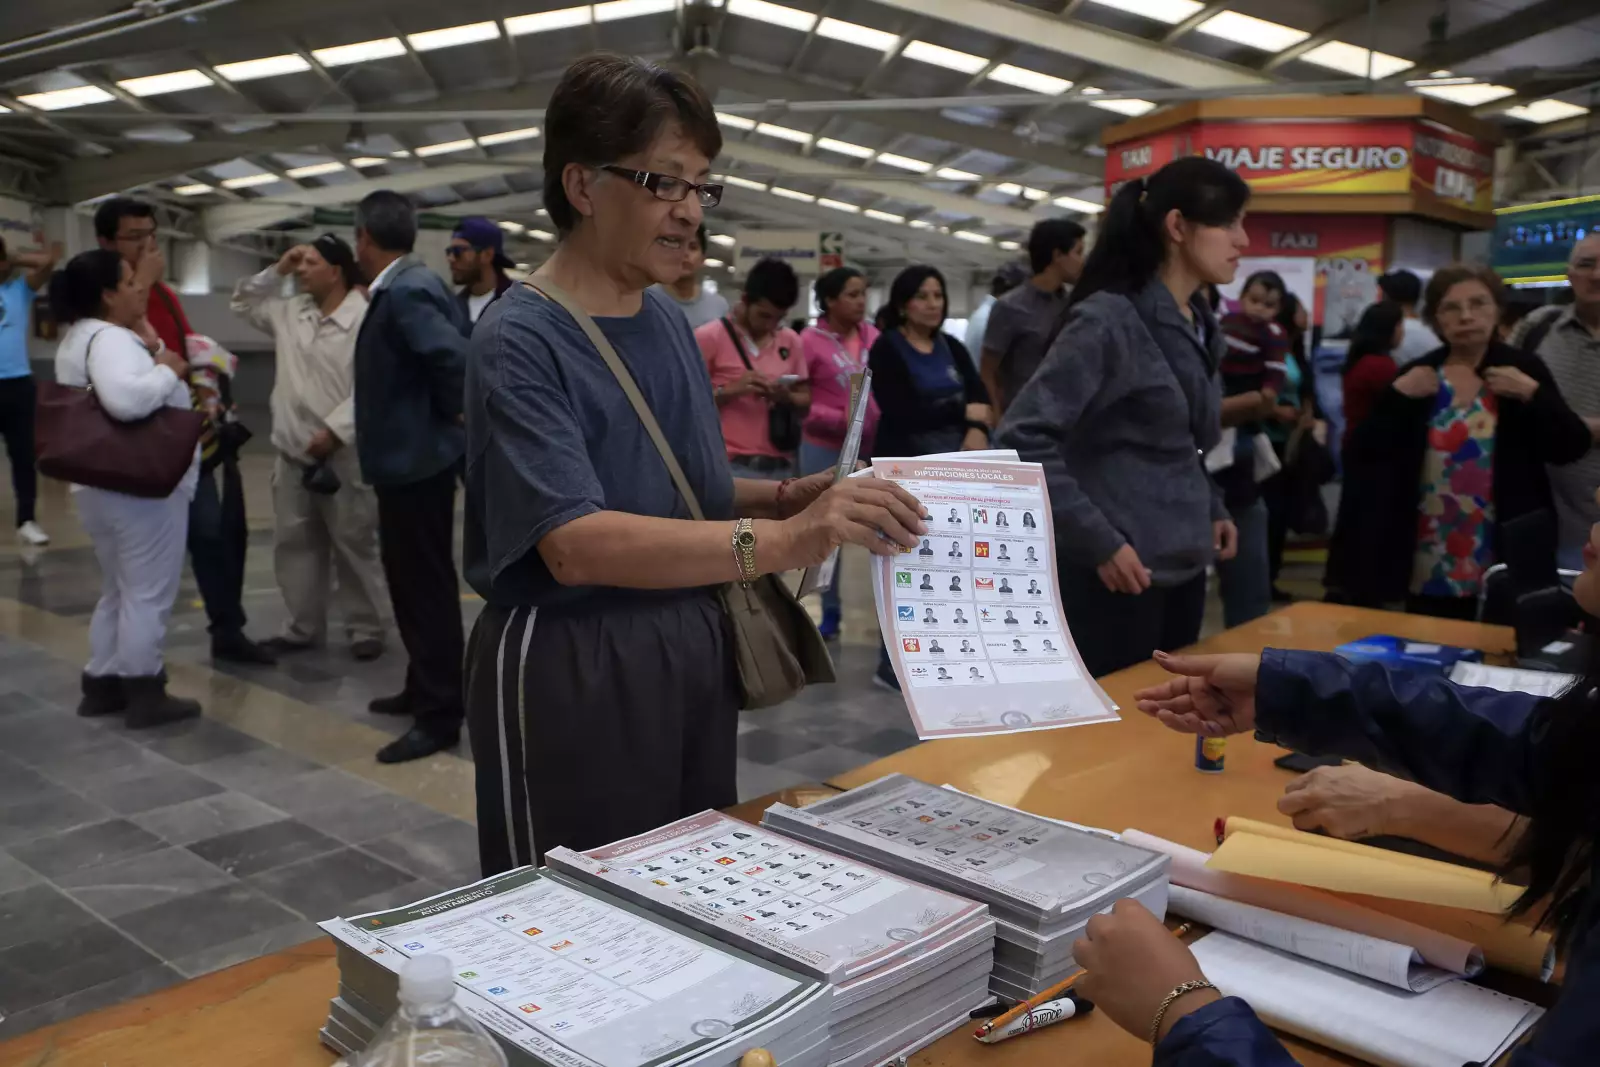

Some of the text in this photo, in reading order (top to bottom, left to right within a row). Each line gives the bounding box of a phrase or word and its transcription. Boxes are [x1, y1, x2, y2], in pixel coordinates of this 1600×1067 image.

[1205, 147, 1284, 170] VIAJE
[1289, 147, 1409, 170] SEGURO
[1270, 232, 1319, 250] TAXI
[914, 470, 1014, 481] DIPUTACIONES LOCALES
[975, 546, 988, 556] PT
[421, 890, 493, 916] AYUNTAMIENTO
[725, 917, 825, 963] DIPUTACIONES LOCALES
